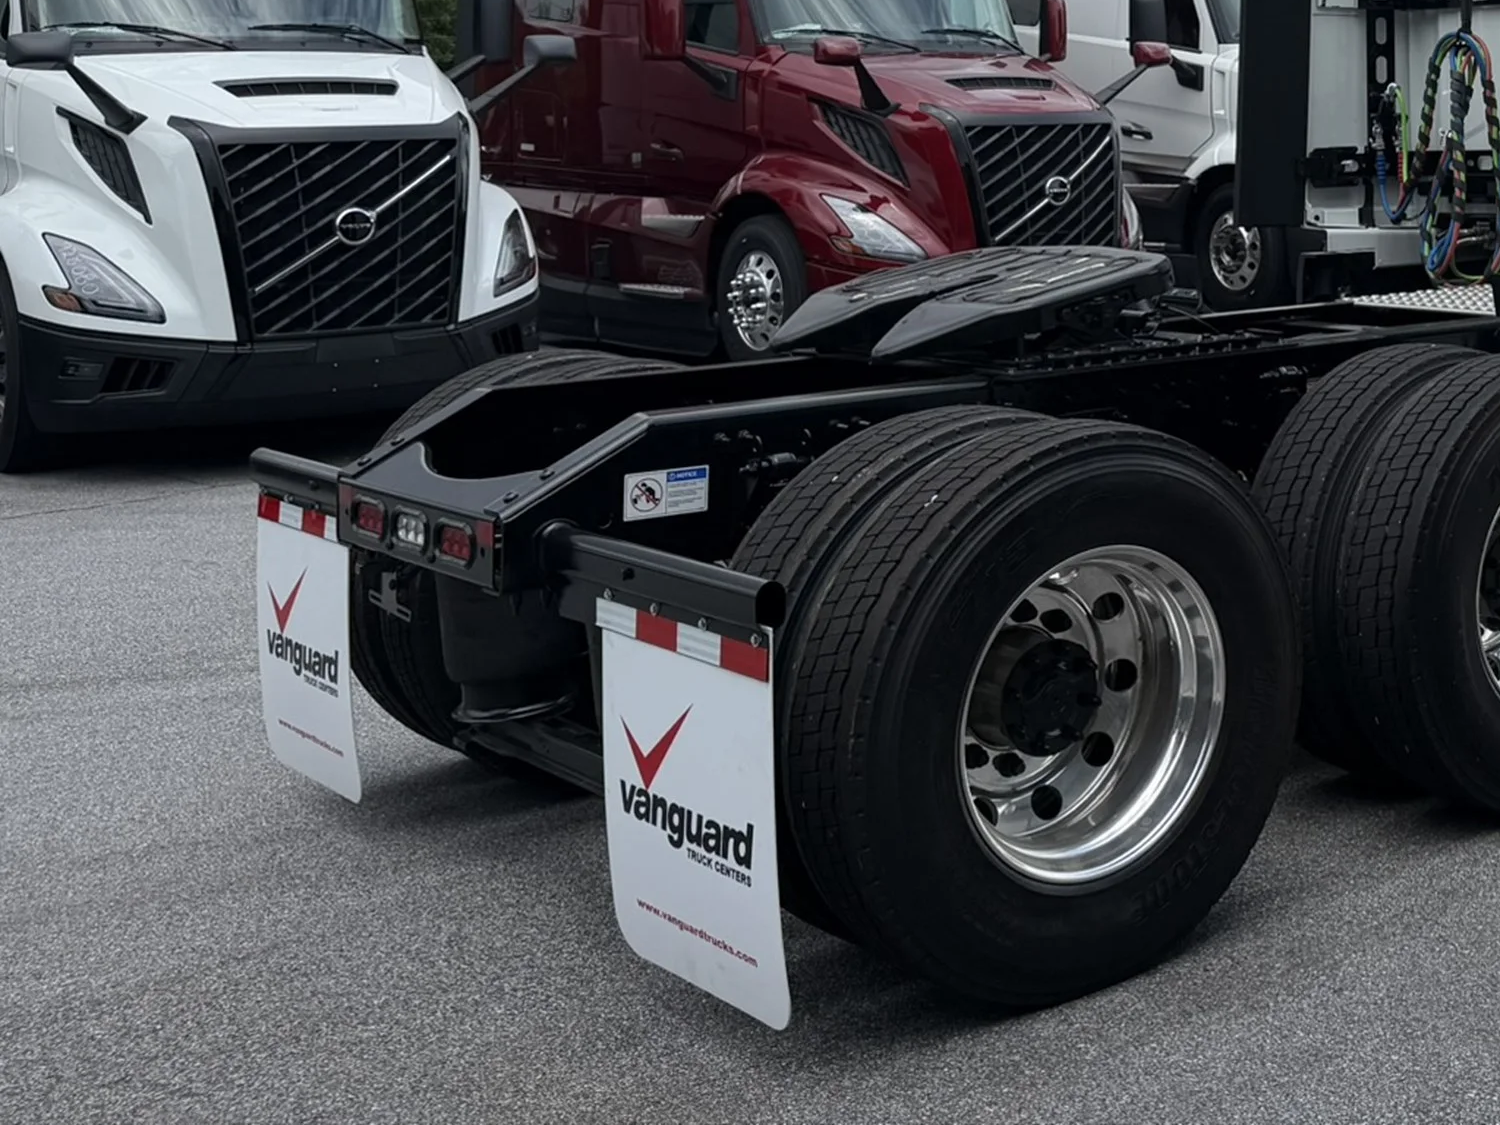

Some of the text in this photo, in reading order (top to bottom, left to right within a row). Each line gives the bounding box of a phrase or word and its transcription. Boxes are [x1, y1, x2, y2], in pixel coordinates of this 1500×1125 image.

[267, 628, 339, 685] vanguard
[620, 778, 754, 870] vanguard
[686, 847, 752, 888] TRUCK CENTERS
[637, 898, 758, 967] www.vanguardtrucks.com
